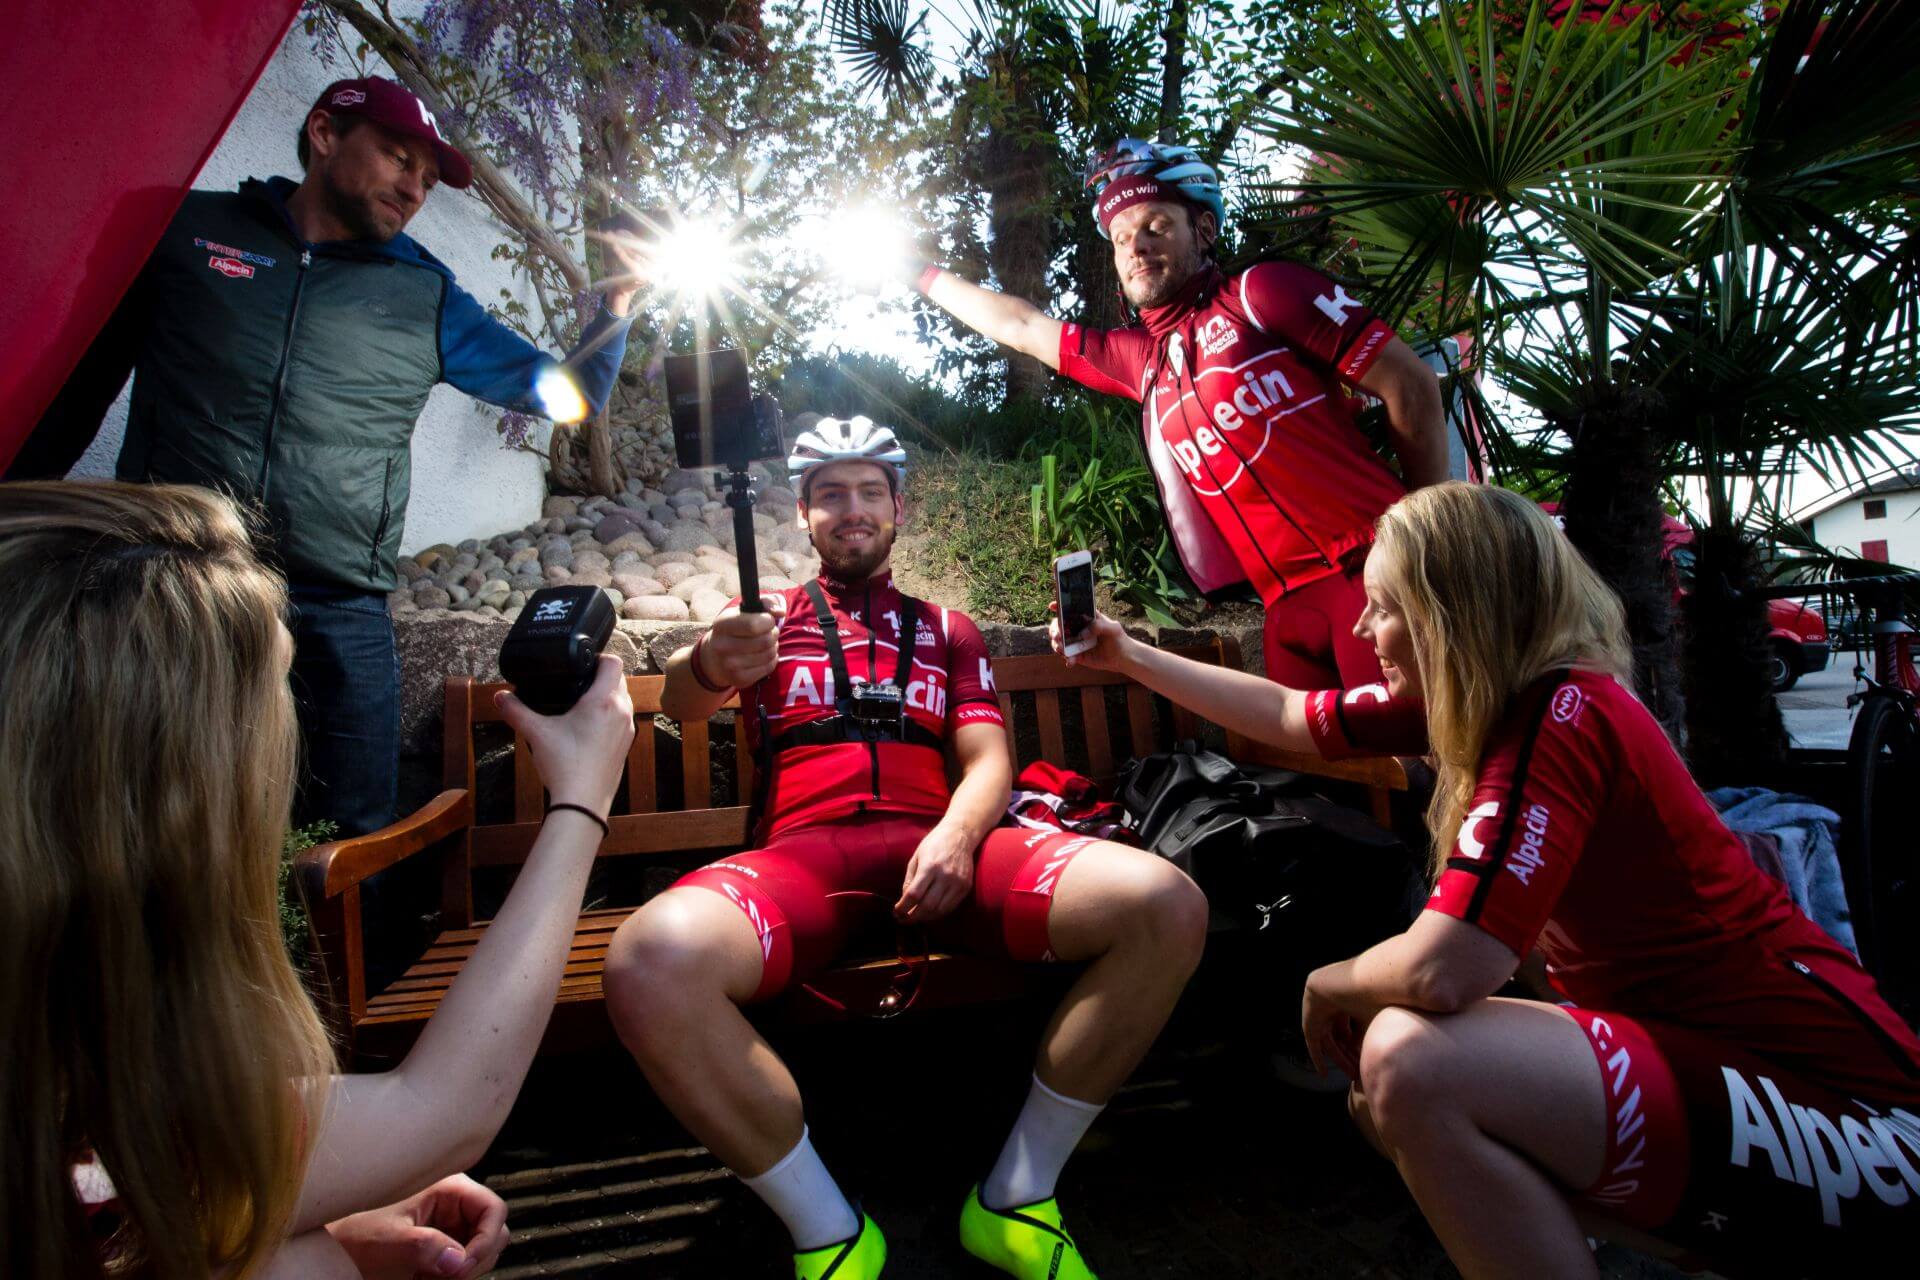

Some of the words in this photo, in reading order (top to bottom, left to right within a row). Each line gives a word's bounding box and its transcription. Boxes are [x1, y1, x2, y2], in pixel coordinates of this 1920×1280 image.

[1103, 195, 1122, 213] race
[1121, 188, 1134, 199] to
[1135, 183, 1158, 195] win
[214, 259, 250, 276] Alpecin
[850, 610, 862, 621] K
[1506, 803, 1550, 887] Alpecin
